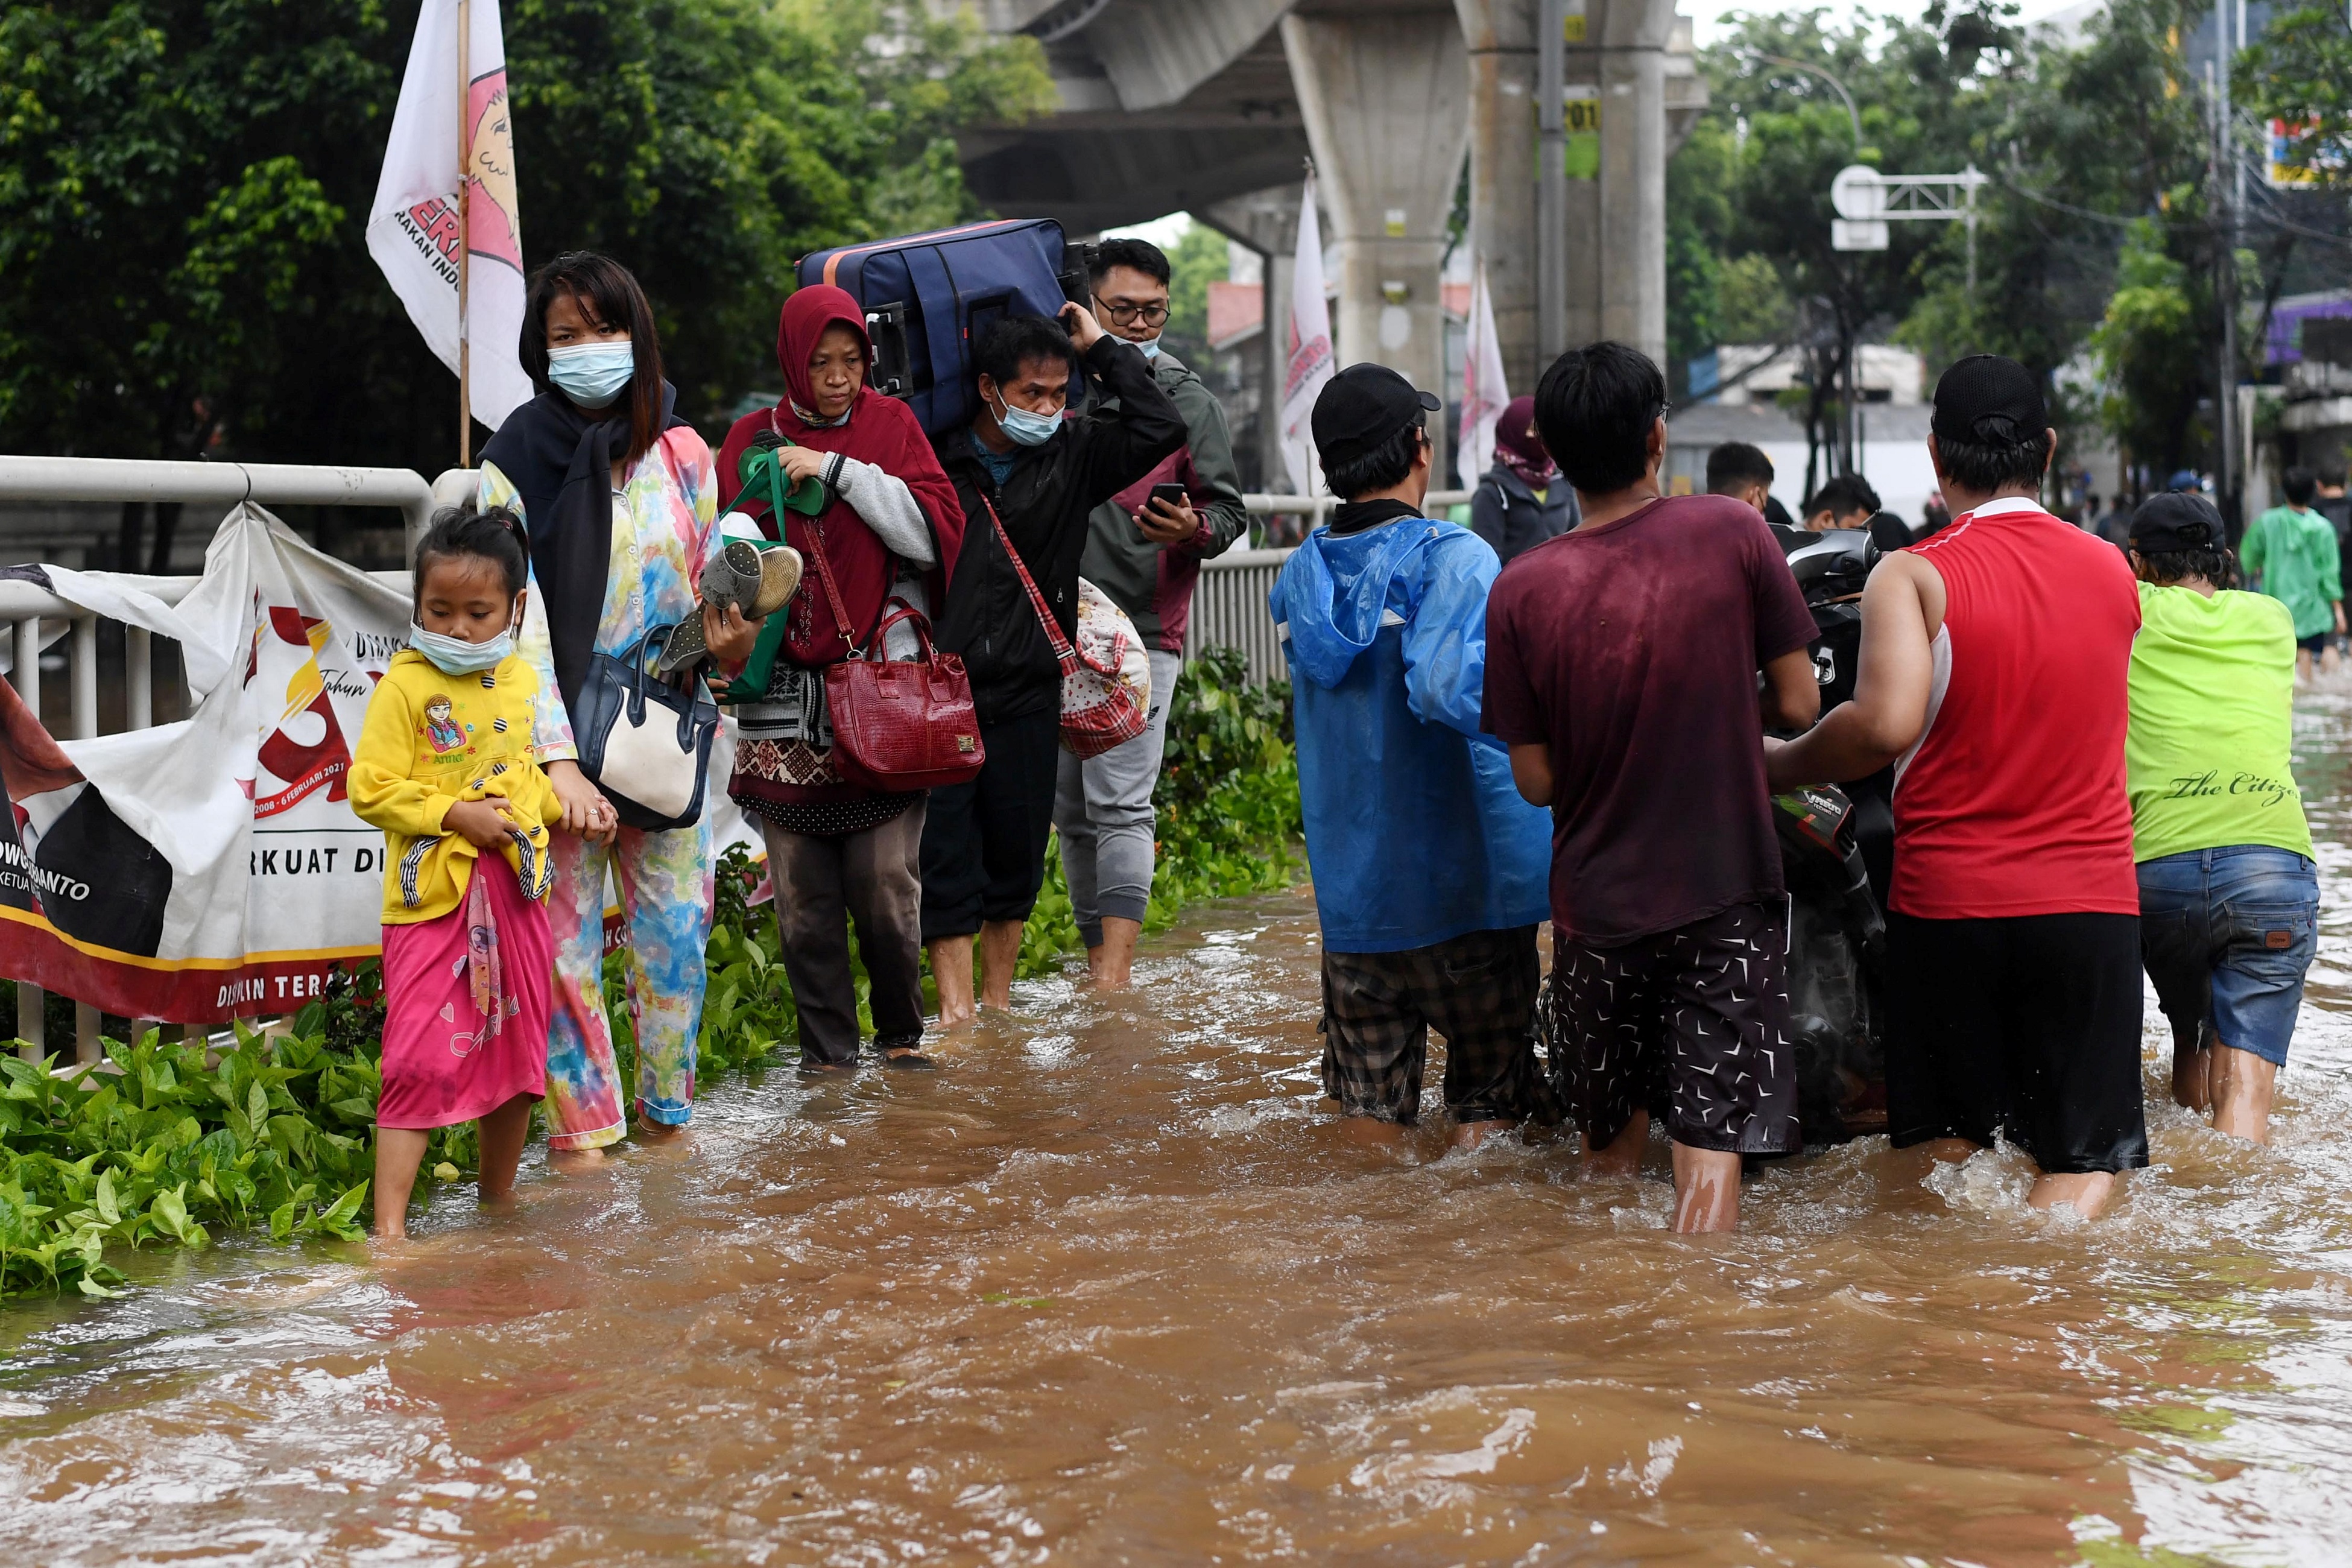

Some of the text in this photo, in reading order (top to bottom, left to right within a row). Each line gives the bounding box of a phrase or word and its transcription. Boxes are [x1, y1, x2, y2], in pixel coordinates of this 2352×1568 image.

[432, 753, 464, 764] Anna
[254, 801, 275, 814] 2008
[286, 771, 323, 802] FEBRUARI
[323, 762, 344, 777] 2021
[2163, 769, 2222, 800] The
